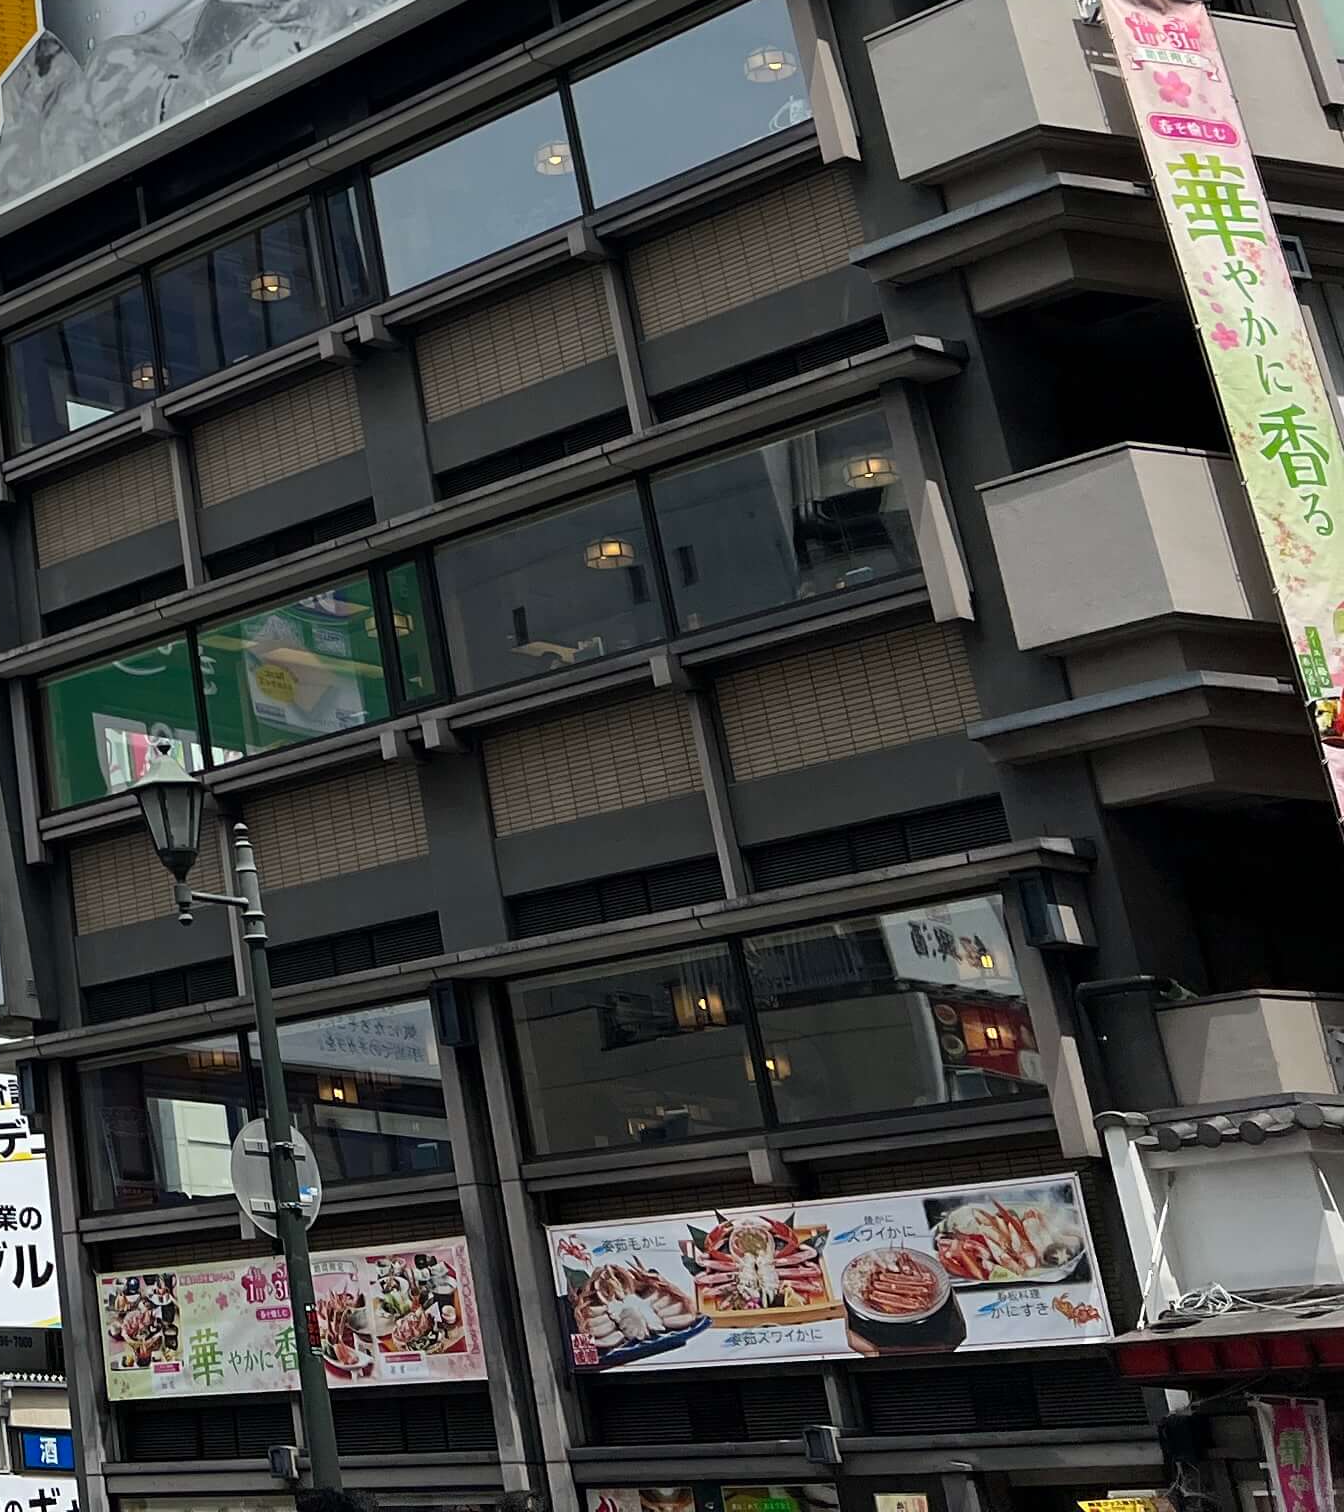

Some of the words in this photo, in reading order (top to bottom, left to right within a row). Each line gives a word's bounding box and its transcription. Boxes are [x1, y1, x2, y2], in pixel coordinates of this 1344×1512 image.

[1166, 151, 1337, 539] 華やかに香る
[991, 1303, 1049, 1319] かにすき
[38, 1437, 58, 1465] 酒
